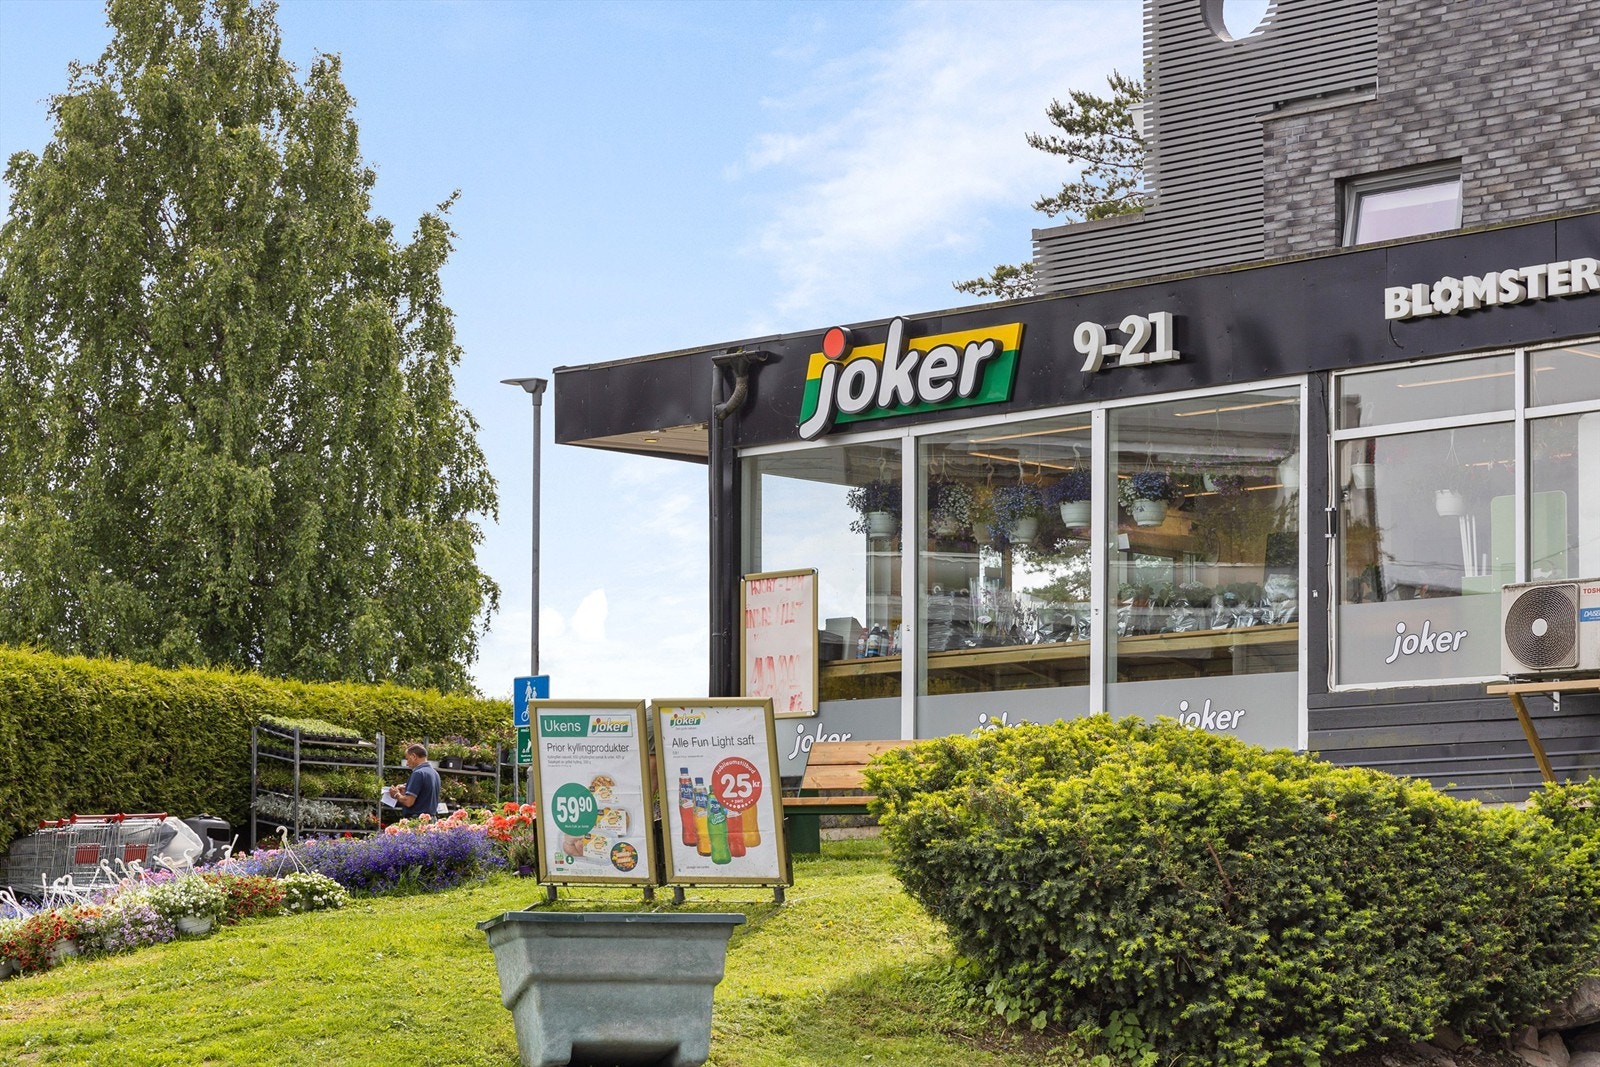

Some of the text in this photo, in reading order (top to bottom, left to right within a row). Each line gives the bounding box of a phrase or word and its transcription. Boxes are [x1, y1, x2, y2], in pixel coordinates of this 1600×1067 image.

[1385, 257, 1600, 320] BLOMSTER
[1073, 311, 1181, 373] 9-21
[799, 316, 1004, 441] joker
[1385, 619, 1468, 664] joker
[544, 717, 628, 735] Ukens joker
[671, 713, 699, 728] joker
[546, 742, 630, 755] Prior kyllingprodukter
[672, 734, 755, 749] Alle Fun Light saft
[720, 773, 761, 799] 25 kr
